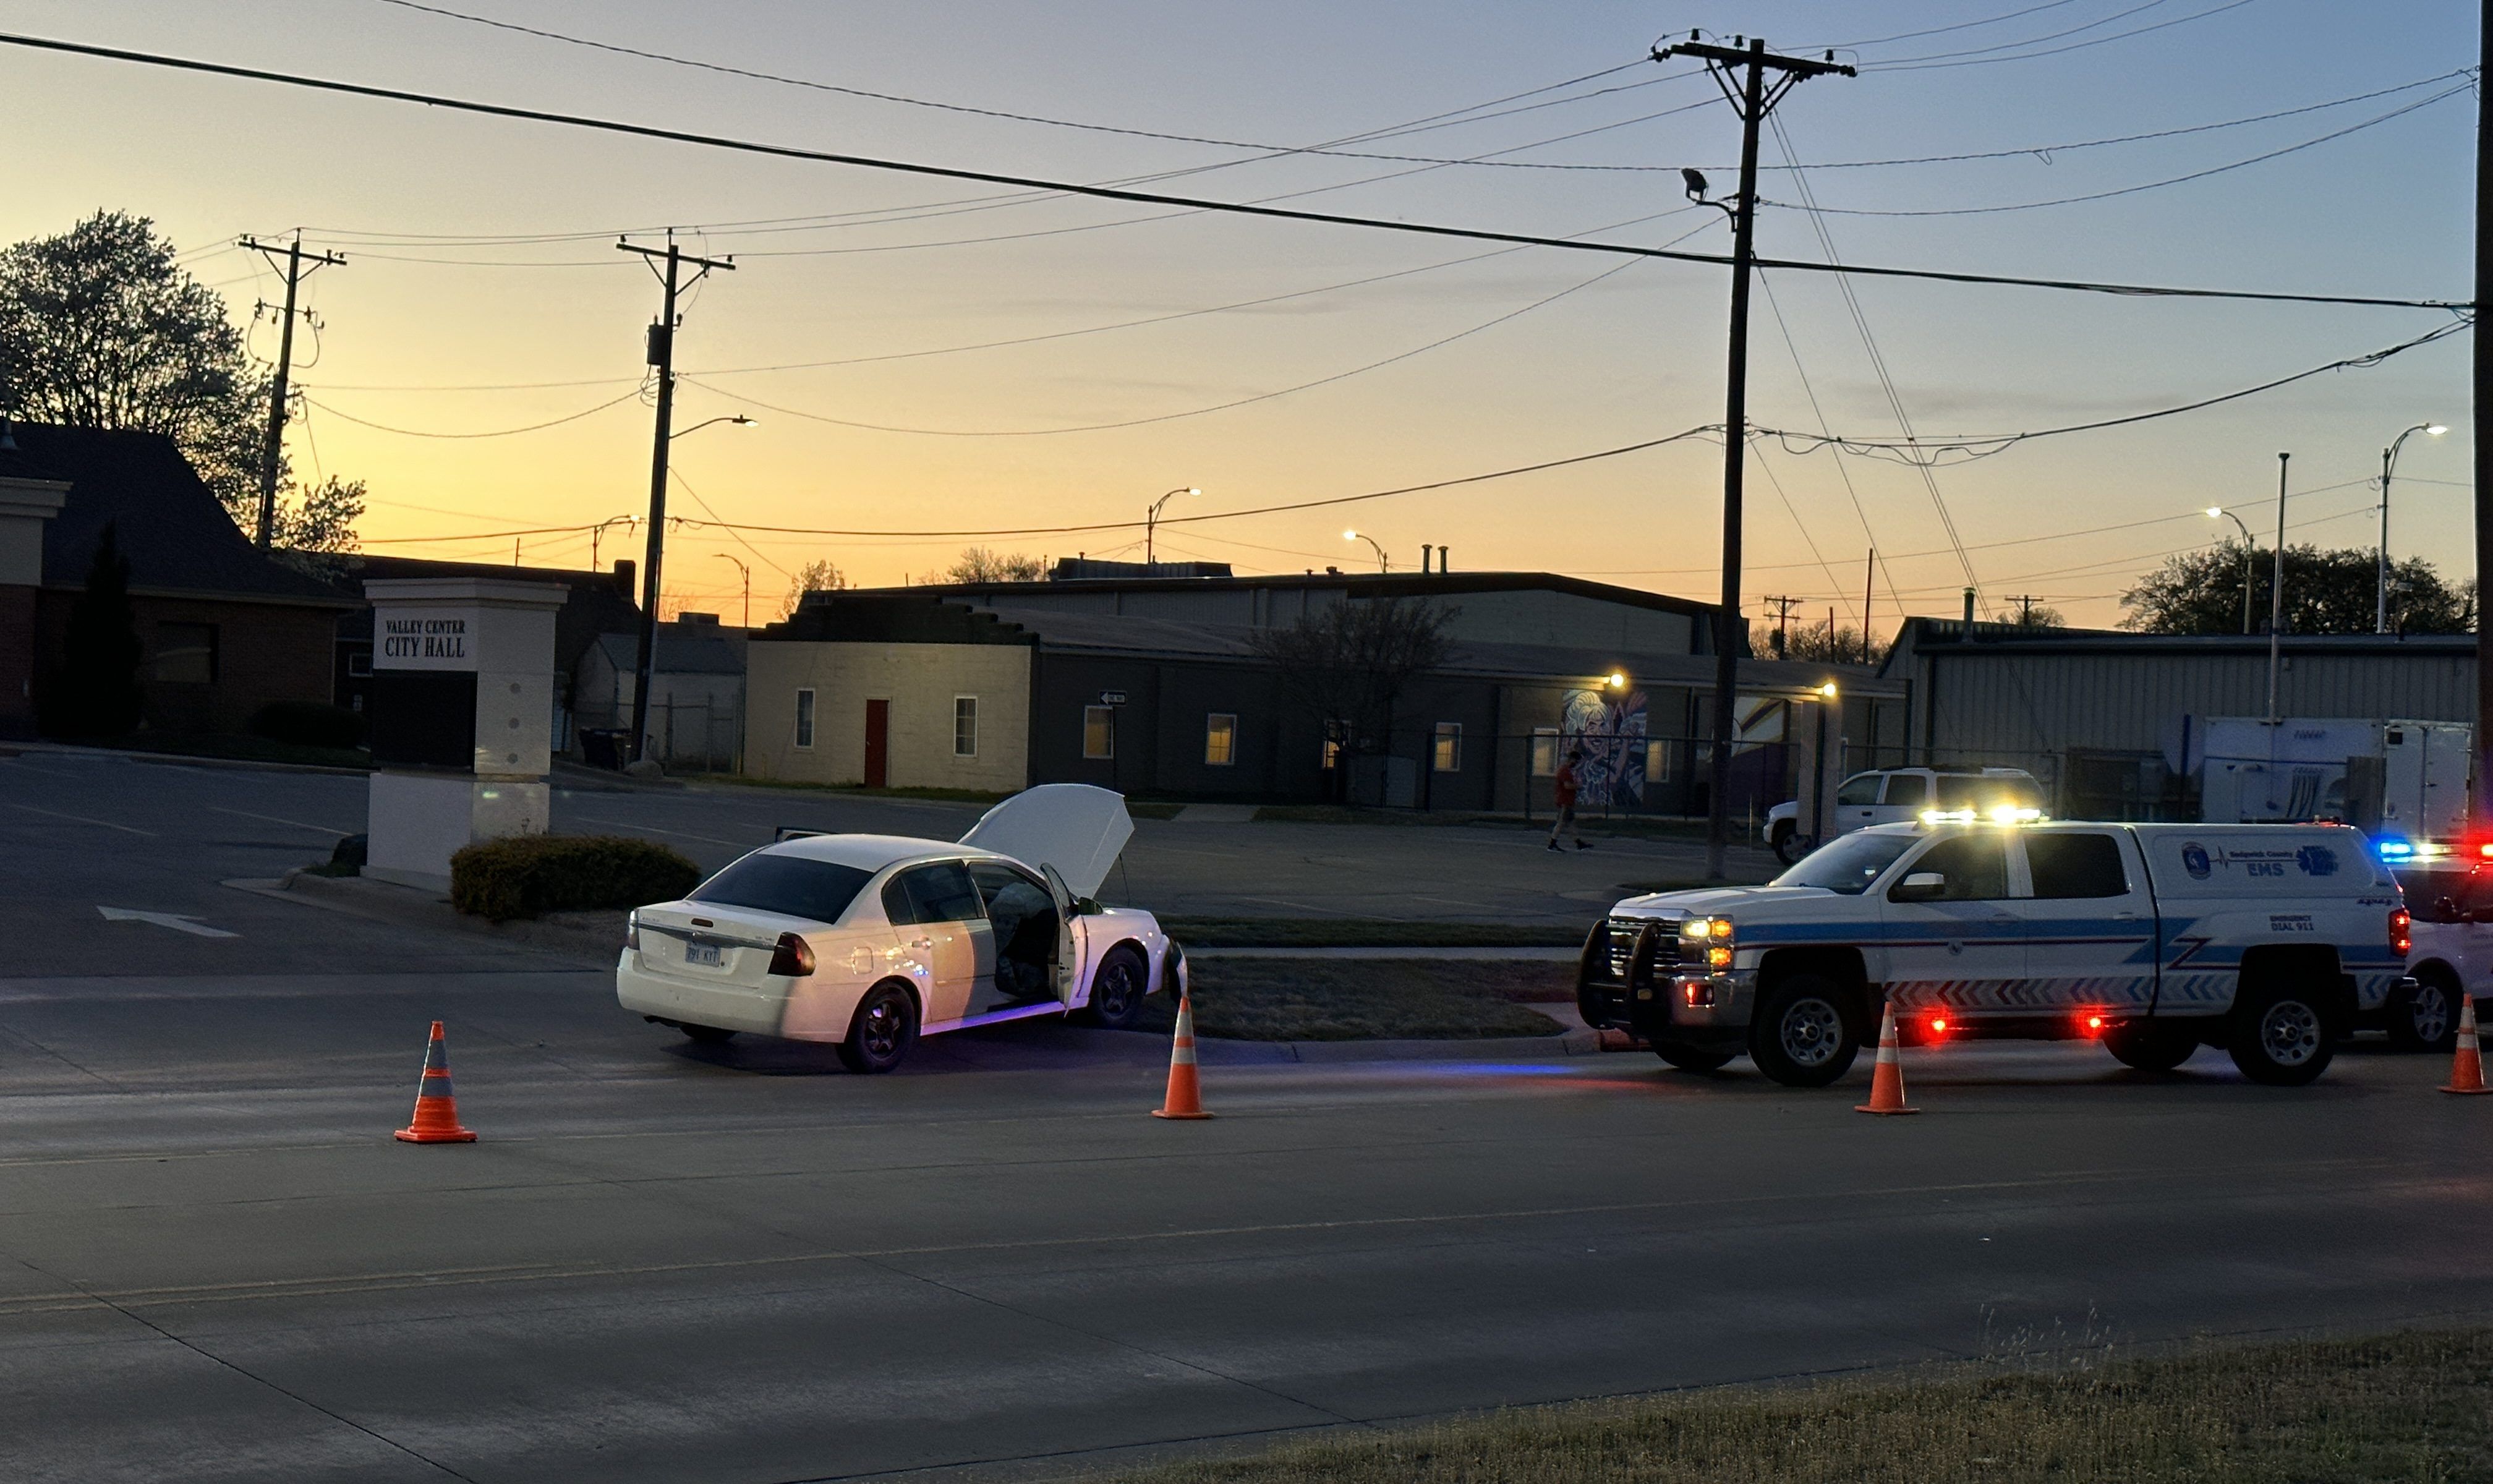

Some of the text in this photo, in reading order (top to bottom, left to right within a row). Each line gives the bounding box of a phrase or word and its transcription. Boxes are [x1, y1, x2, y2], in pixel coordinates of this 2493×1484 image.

[386, 620, 466, 634] VALLEY CENTER
[385, 636, 465, 657] CITY HALL
[2246, 863, 2285, 876] EMS
[2272, 922, 2314, 931] DIAL 911
